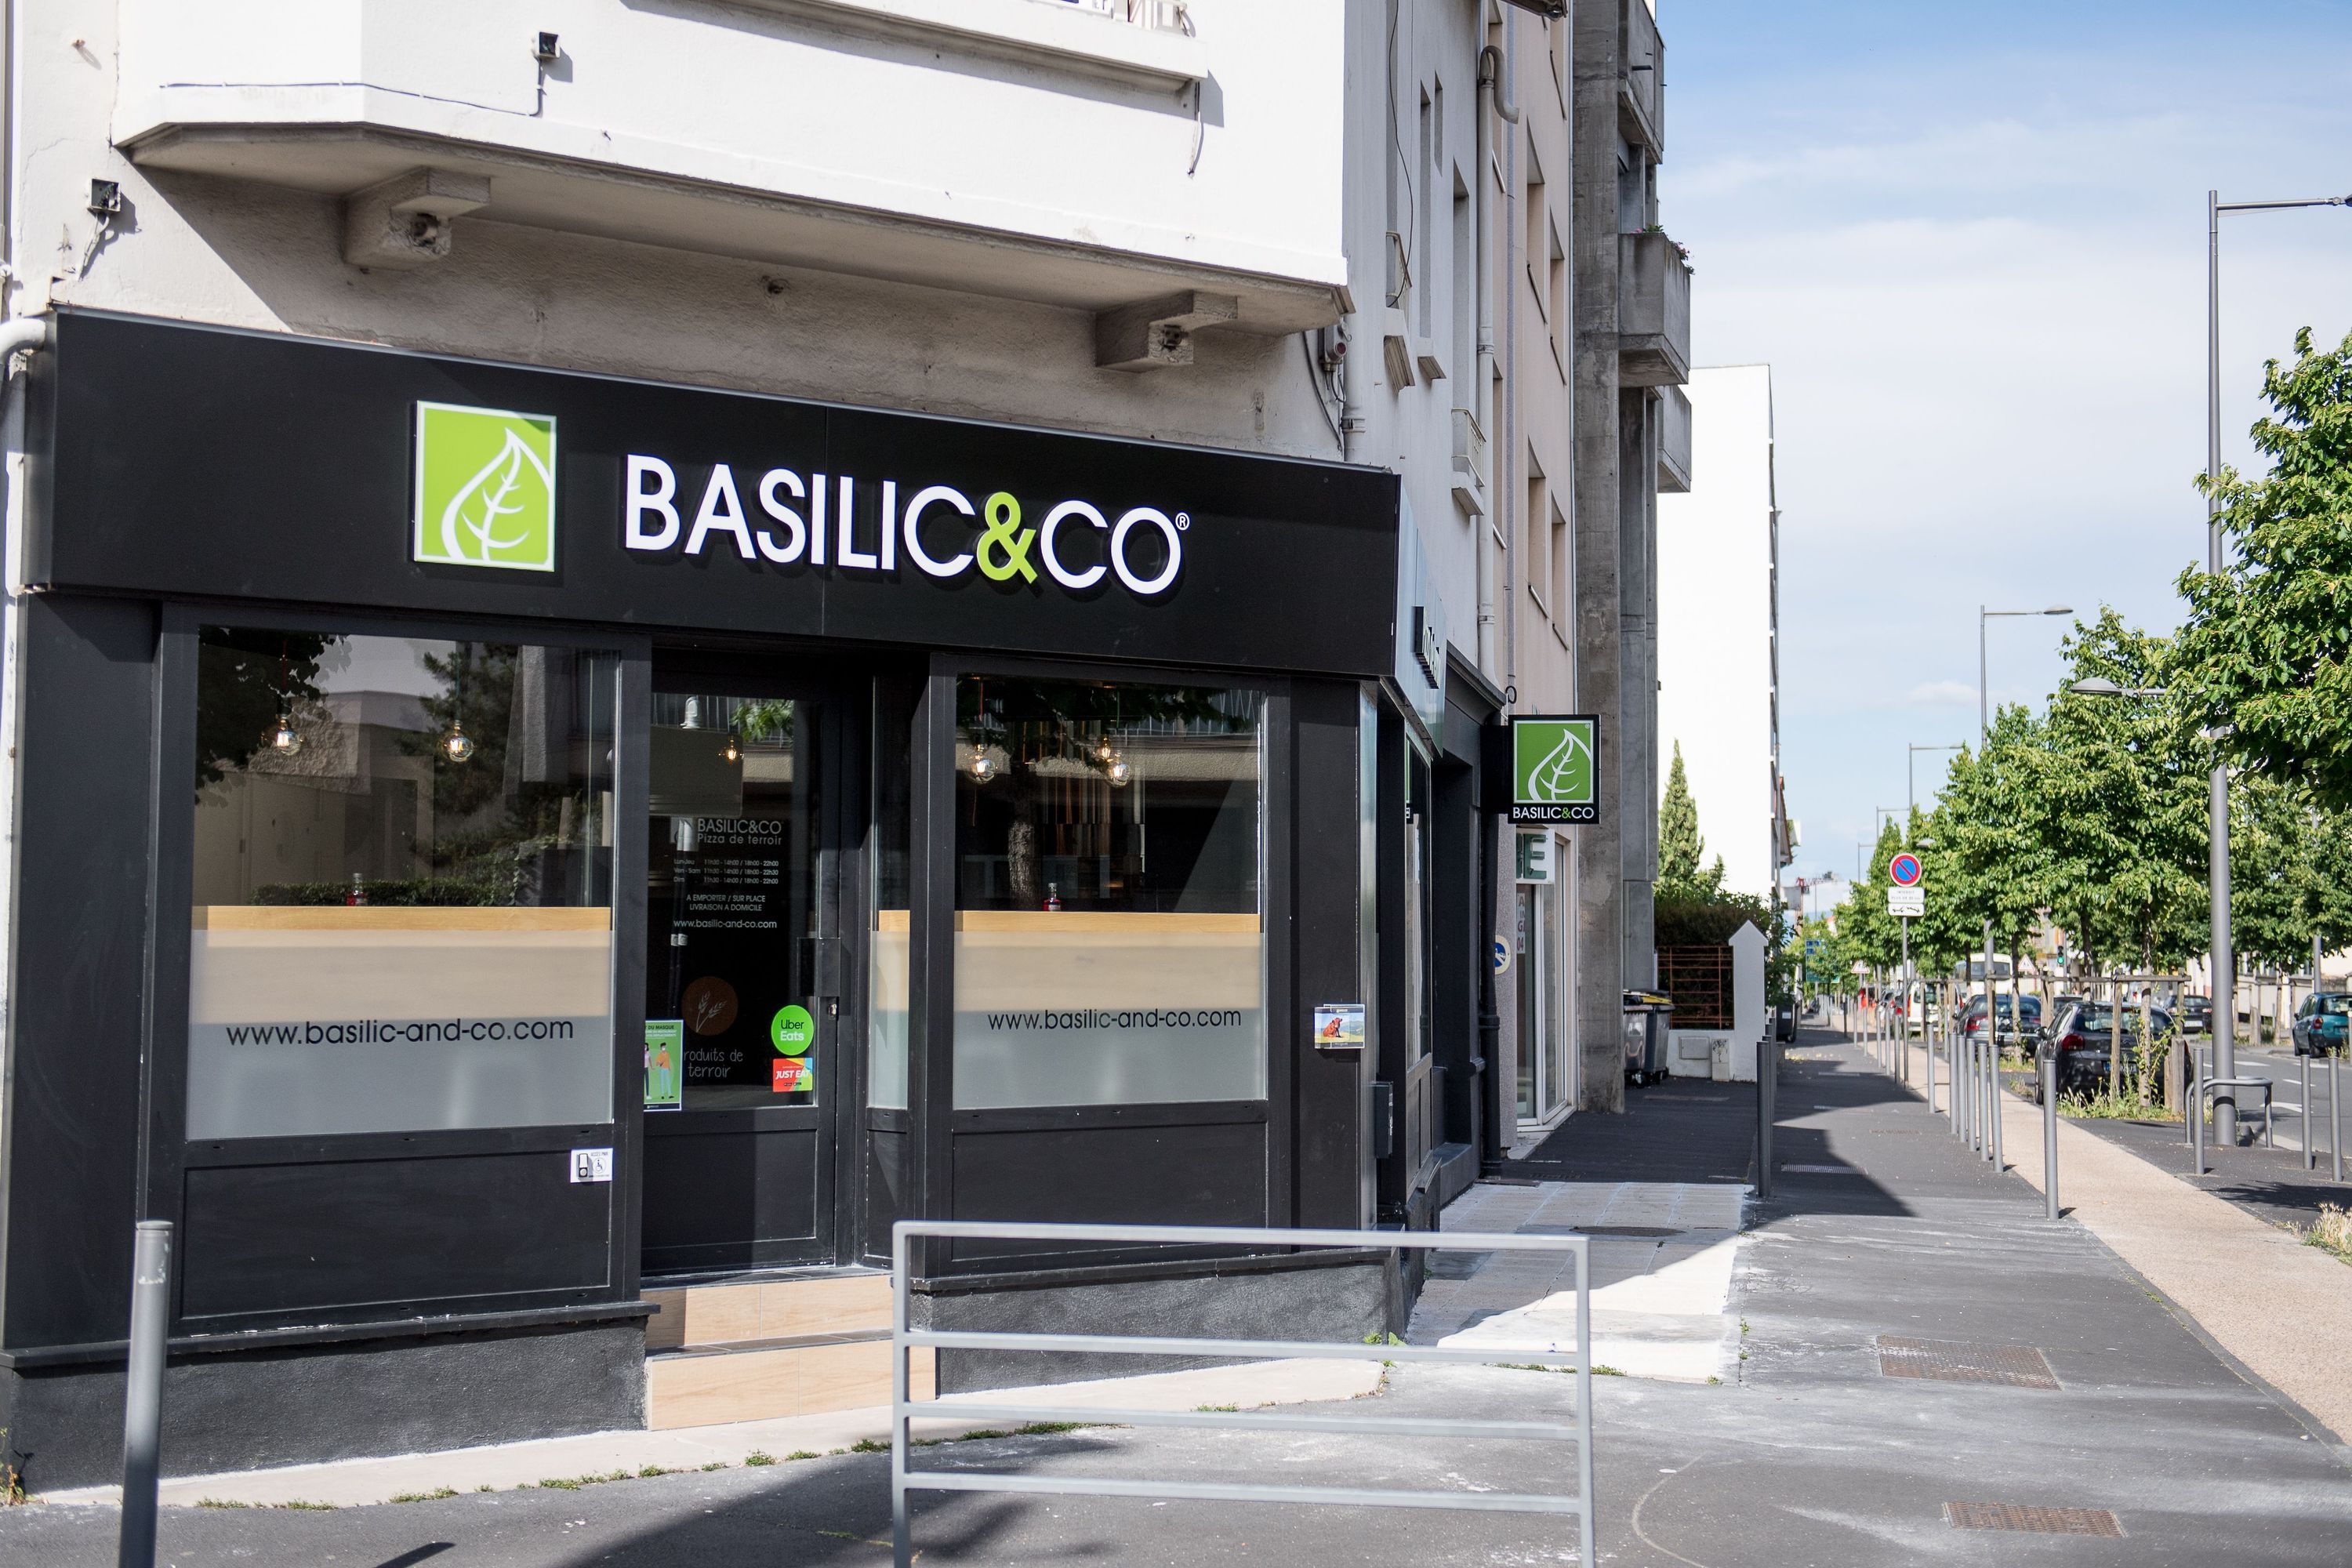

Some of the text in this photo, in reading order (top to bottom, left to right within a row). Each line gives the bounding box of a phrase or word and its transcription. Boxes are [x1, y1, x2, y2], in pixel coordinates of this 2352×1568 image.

[1512, 807, 1595, 819] BASILIC&CO
[697, 818, 782, 834] BASILIC&CO
[697, 833, 782, 845] Pizza de terroir
[673, 918, 778, 929] www.basilic-and-co.com
[781, 1019, 804, 1029] Uber
[988, 1008, 1242, 1030] www.basilic-and-co.com
[226, 1018, 575, 1046] www.basilic-and-co.com
[780, 1031, 804, 1042] Eats
[683, 1047, 743, 1062] roduits de
[688, 1062, 731, 1078] terroir
[775, 1069, 811, 1080] JUST EAT
